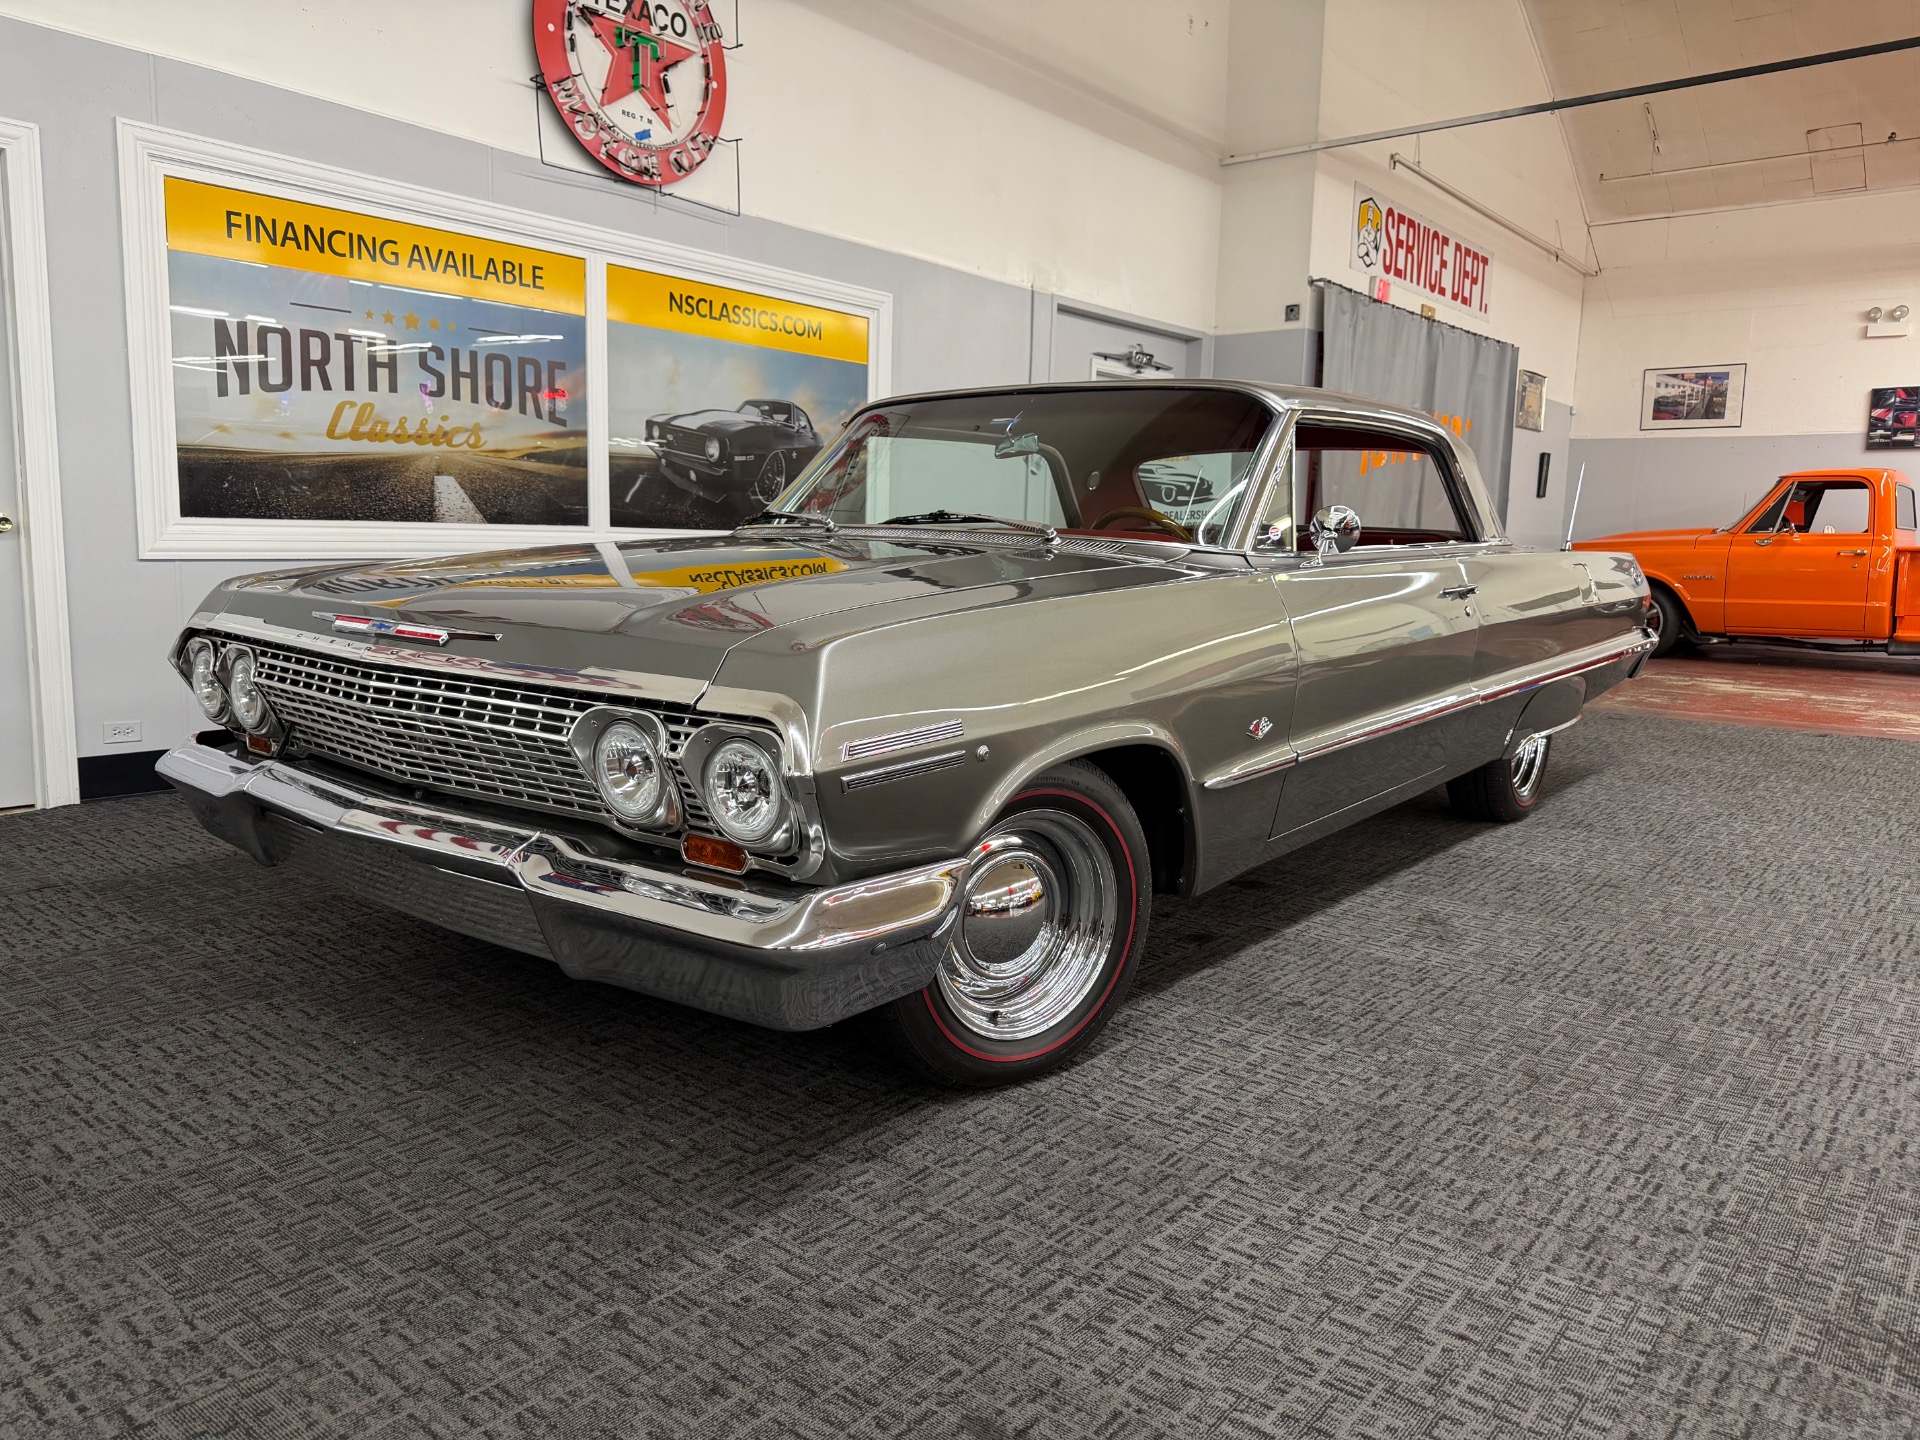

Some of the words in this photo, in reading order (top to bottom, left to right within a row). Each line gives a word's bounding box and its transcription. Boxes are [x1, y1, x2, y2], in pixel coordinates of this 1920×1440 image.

[595, 0, 688, 38] EXACO
[552, 78, 663, 181] MOTOR
[669, 131, 718, 176] OIL
[225, 209, 399, 267] FINANCING
[407, 243, 545, 291] AVAILABLE
[1382, 207, 1450, 296] SERVICE
[1451, 242, 1489, 313] DEPT.
[668, 291, 822, 341] NSCLASSICS.COM
[213, 318, 398, 399] NORTH
[418, 344, 567, 429] SHORE
[325, 400, 488, 450] Classics
[1164, 509, 1216, 521] DEALERSH
[295, 632, 489, 667] CHEVROLET
